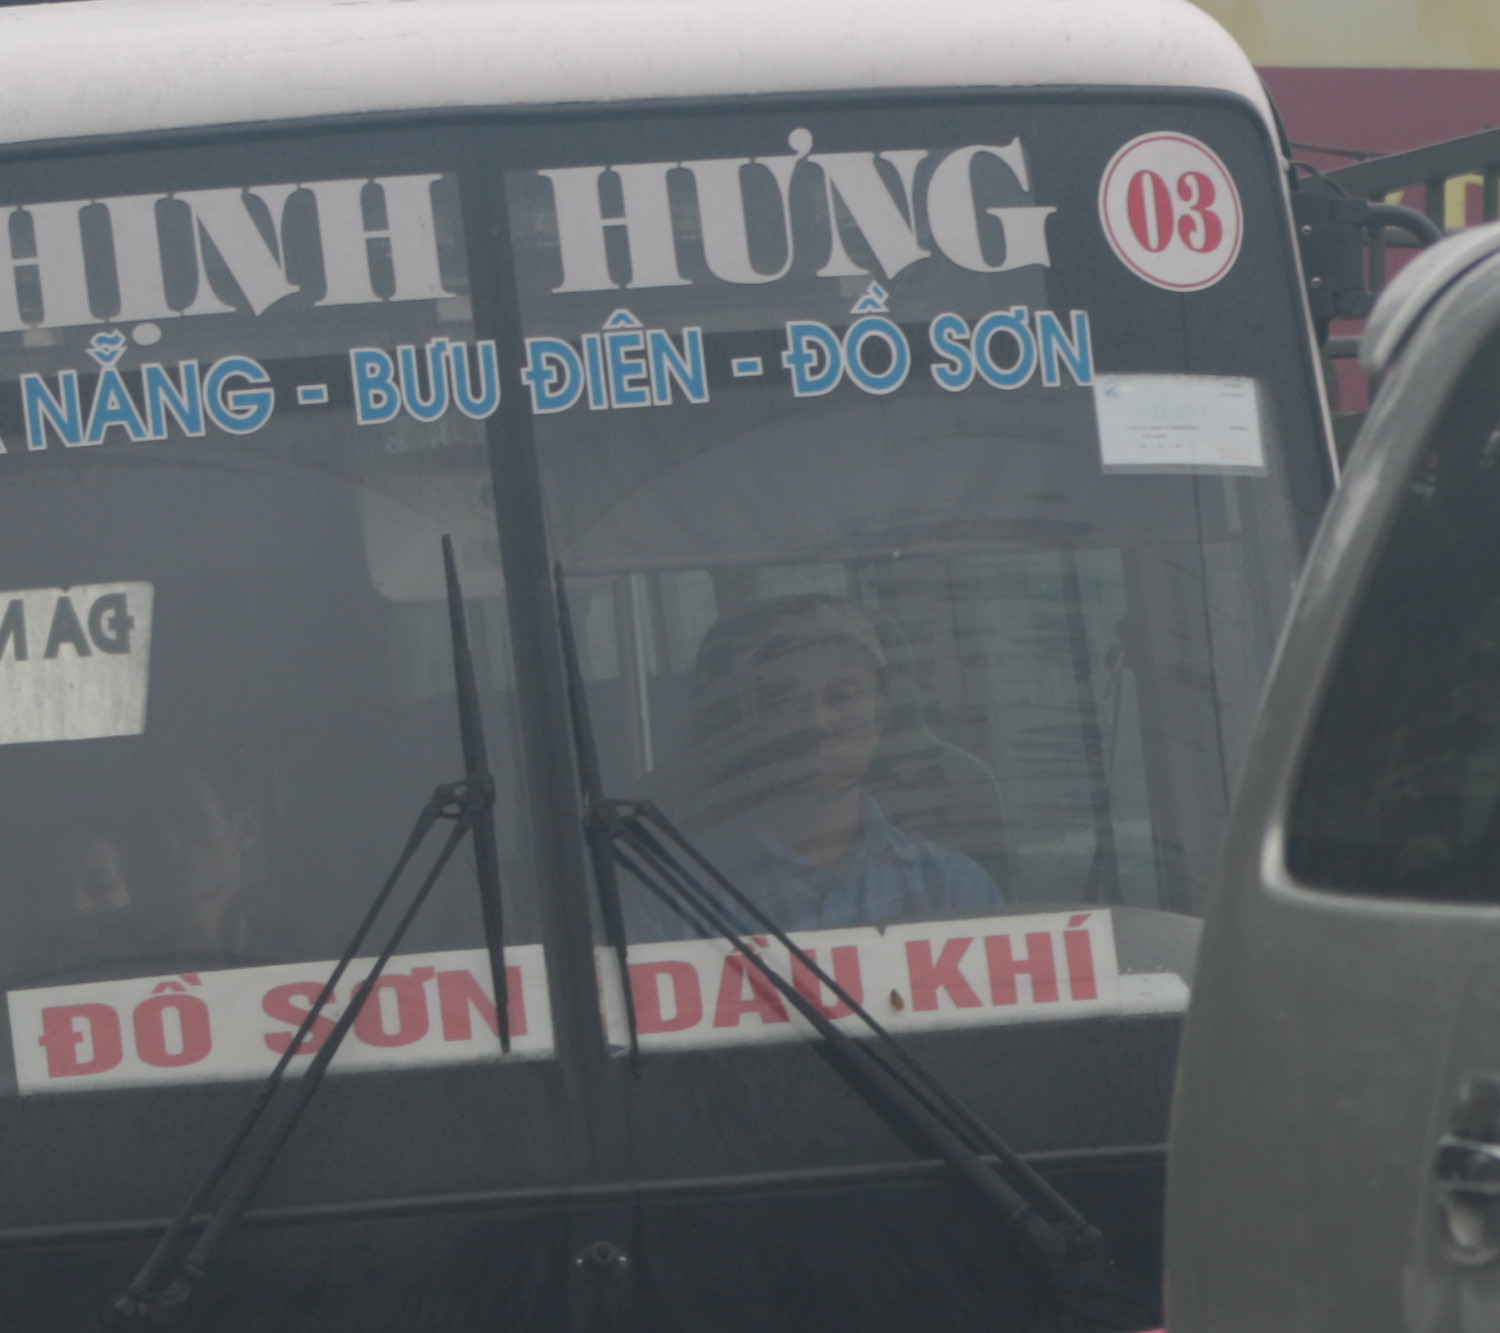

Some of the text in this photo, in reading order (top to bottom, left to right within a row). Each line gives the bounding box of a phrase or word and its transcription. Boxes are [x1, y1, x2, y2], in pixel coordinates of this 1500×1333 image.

[536, 127, 1057, 294] HƯNG
[1126, 169, 1223, 254] 03
[20, 329, 275, 452] NẴNG
[350, 337, 500, 425] BƯU
[782, 281, 910, 397] ĐỒ
[929, 305, 1096, 392] SƠN
[38, 966, 529, 1079] ĐỒ SƠN
[627, 913, 1099, 1035] DẦU KHÍ
